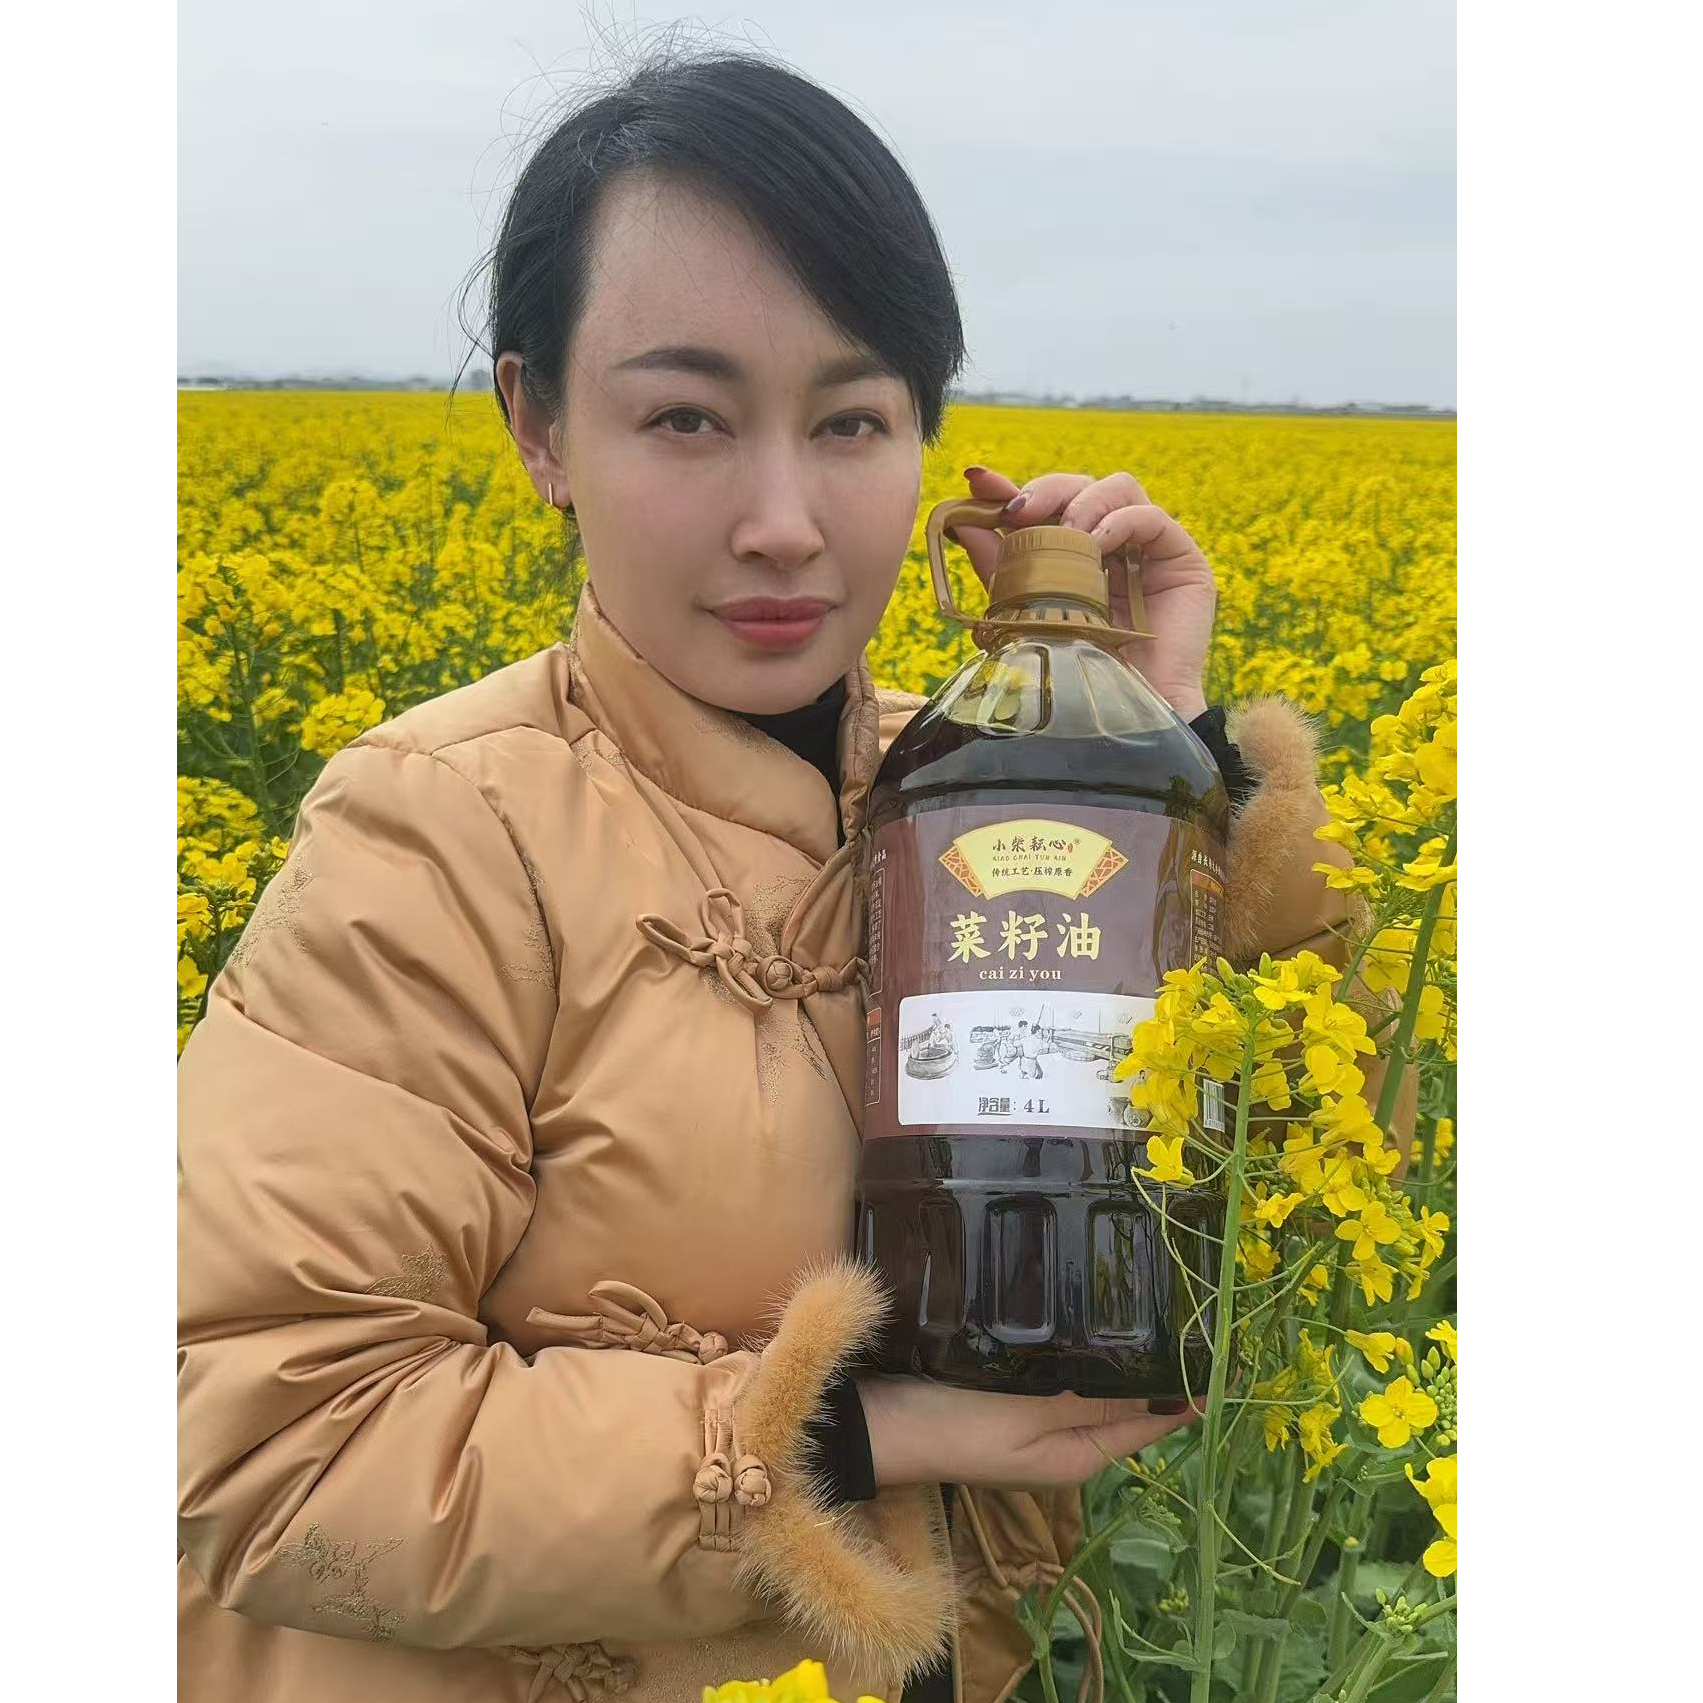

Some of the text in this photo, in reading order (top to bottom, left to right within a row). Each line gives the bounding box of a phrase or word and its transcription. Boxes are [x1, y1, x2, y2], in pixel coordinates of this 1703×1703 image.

[992, 835, 1067, 853] 小柴耘心
[946, 910, 1102, 964] 菜籽油
[979, 965, 1062, 982] cai zi you
